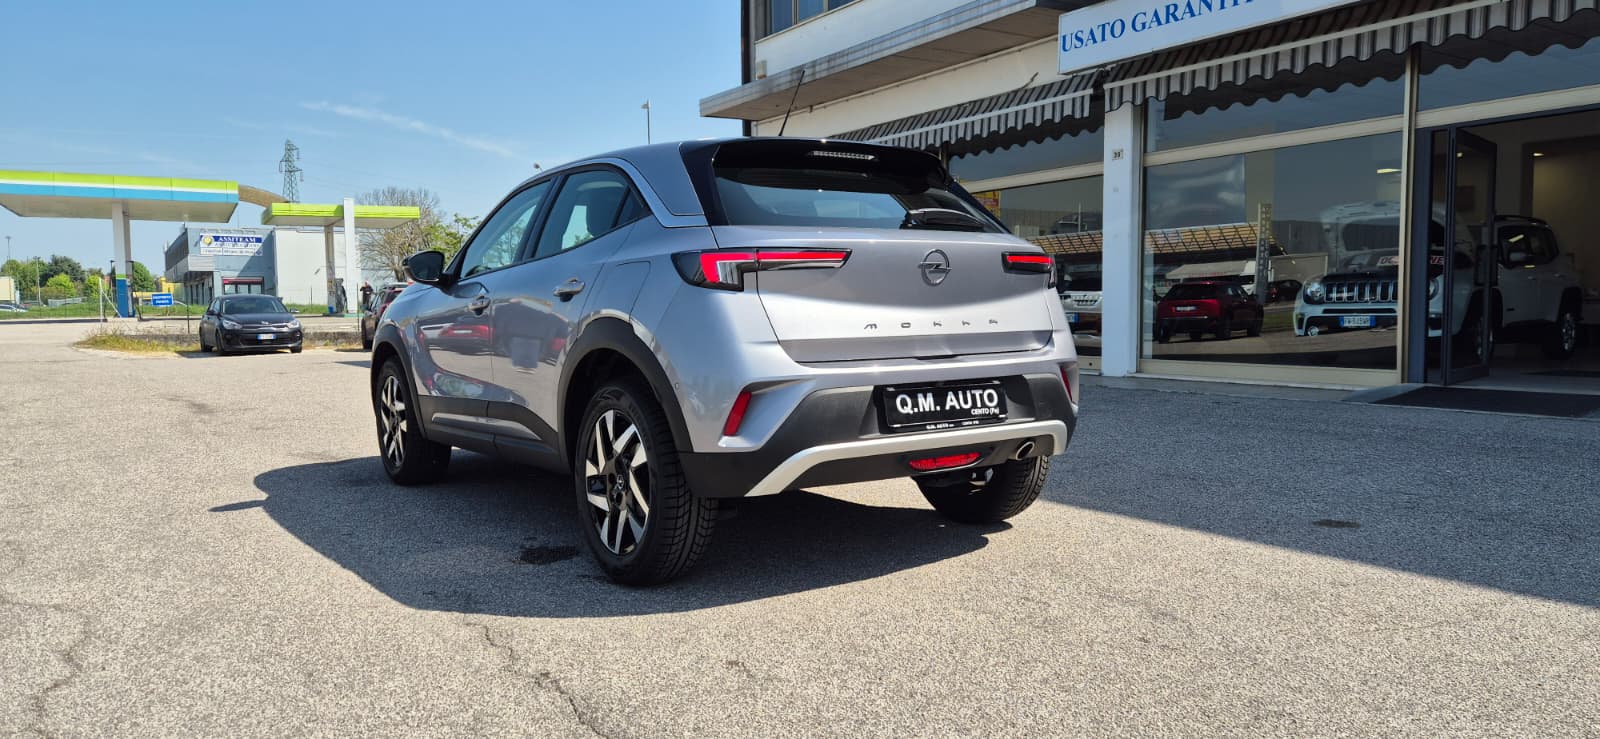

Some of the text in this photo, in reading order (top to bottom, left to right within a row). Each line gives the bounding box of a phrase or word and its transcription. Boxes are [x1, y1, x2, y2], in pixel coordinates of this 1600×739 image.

[1061, 18, 1126, 52] USATO
[895, 388, 998, 415] Q.M. AUTO
